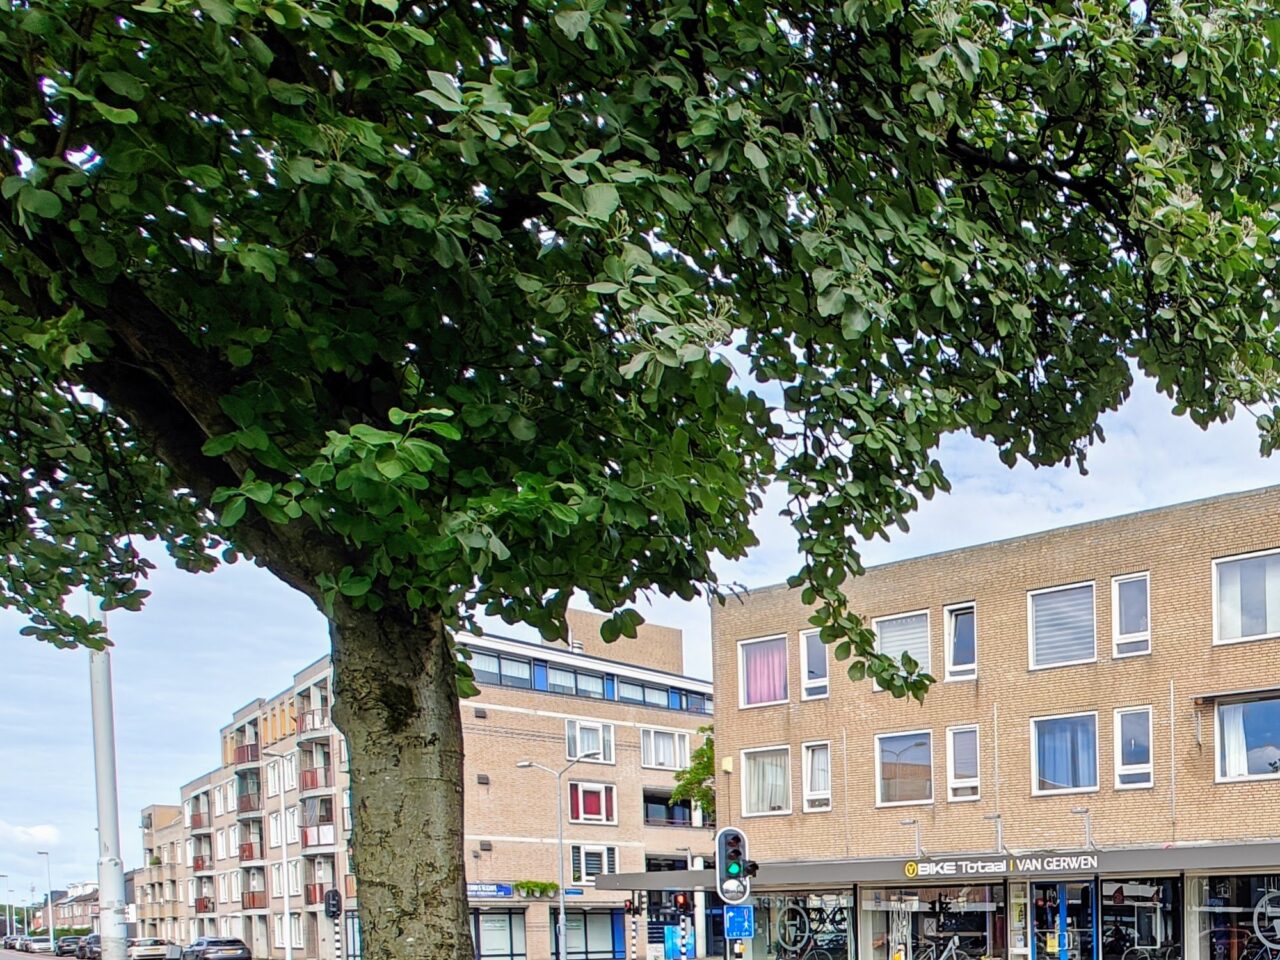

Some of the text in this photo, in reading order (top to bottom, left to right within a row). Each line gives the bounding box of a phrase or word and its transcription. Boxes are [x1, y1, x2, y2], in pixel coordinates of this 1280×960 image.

[918, 855, 1098, 875] BIKE Totaal VAN GERWEN
